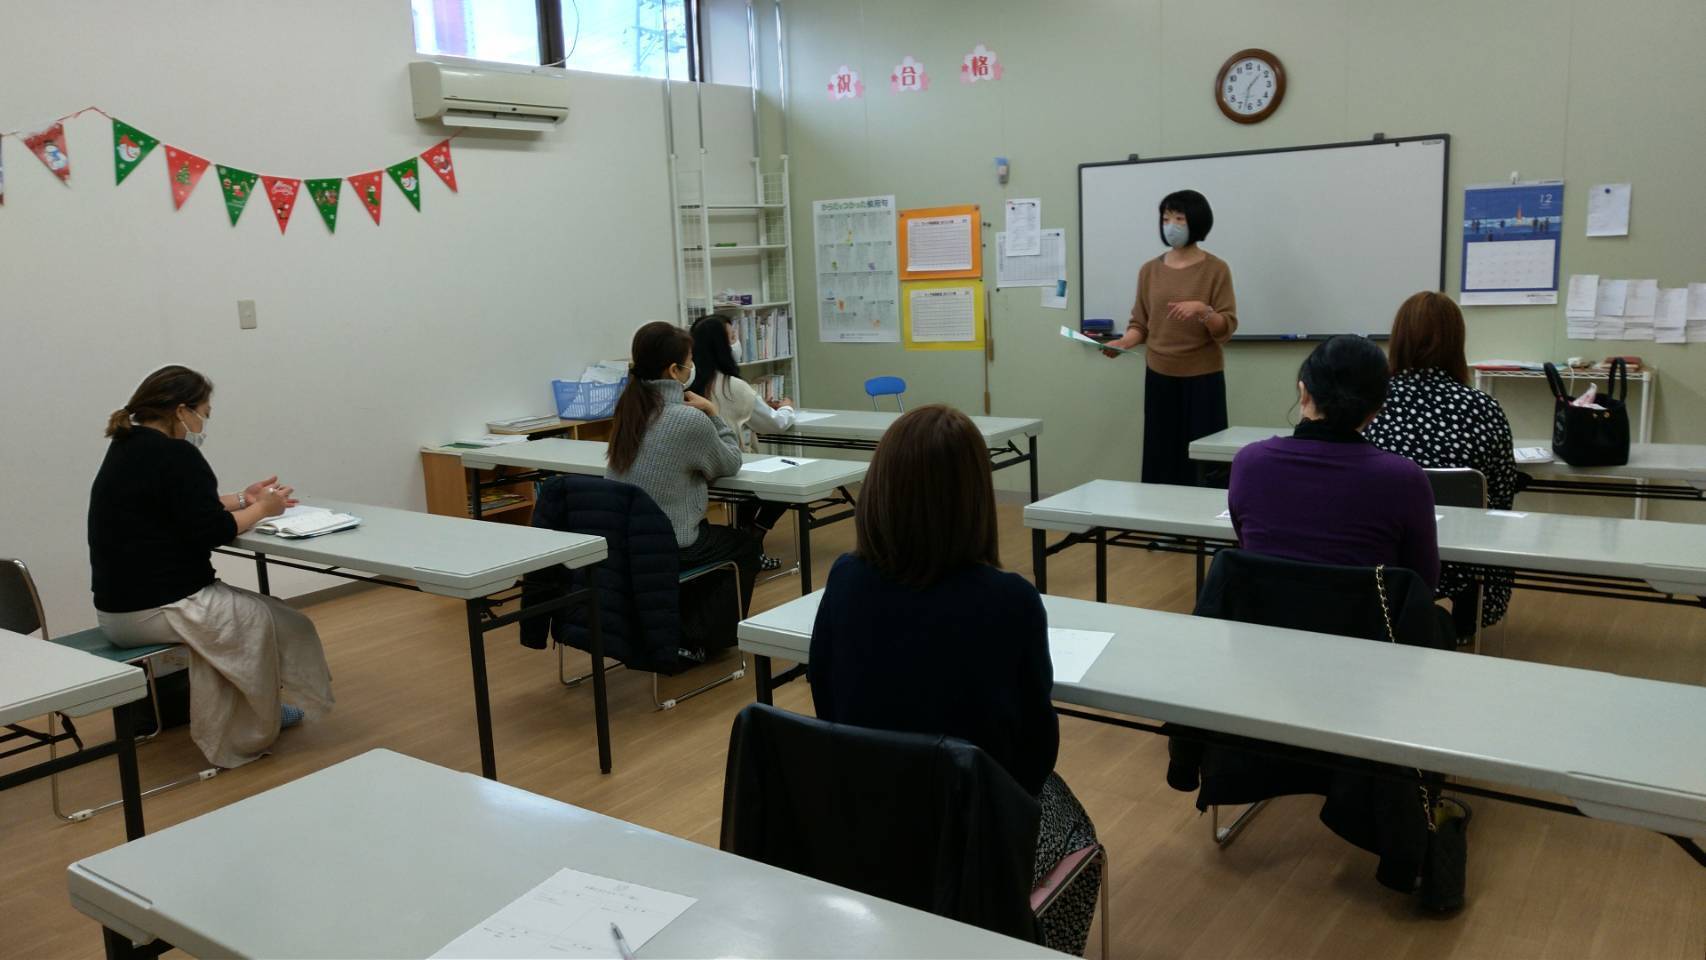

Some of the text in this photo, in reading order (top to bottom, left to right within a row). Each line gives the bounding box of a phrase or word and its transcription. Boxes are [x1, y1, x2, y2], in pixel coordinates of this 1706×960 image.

[1245, 62, 1253, 71] 12
[838, 56, 988, 93] 祝 合 格
[1263, 70, 1269, 78] 2
[1265, 80, 1272, 88] 3
[1227, 85, 1234, 94] 9
[1230, 94, 1237, 103] 8
[1262, 91, 1269, 99] 4
[1236, 101, 1243, 110] 7
[1247, 102, 1253, 111] 6
[1256, 99, 1263, 107] 5
[1540, 193, 1552, 203] 12
